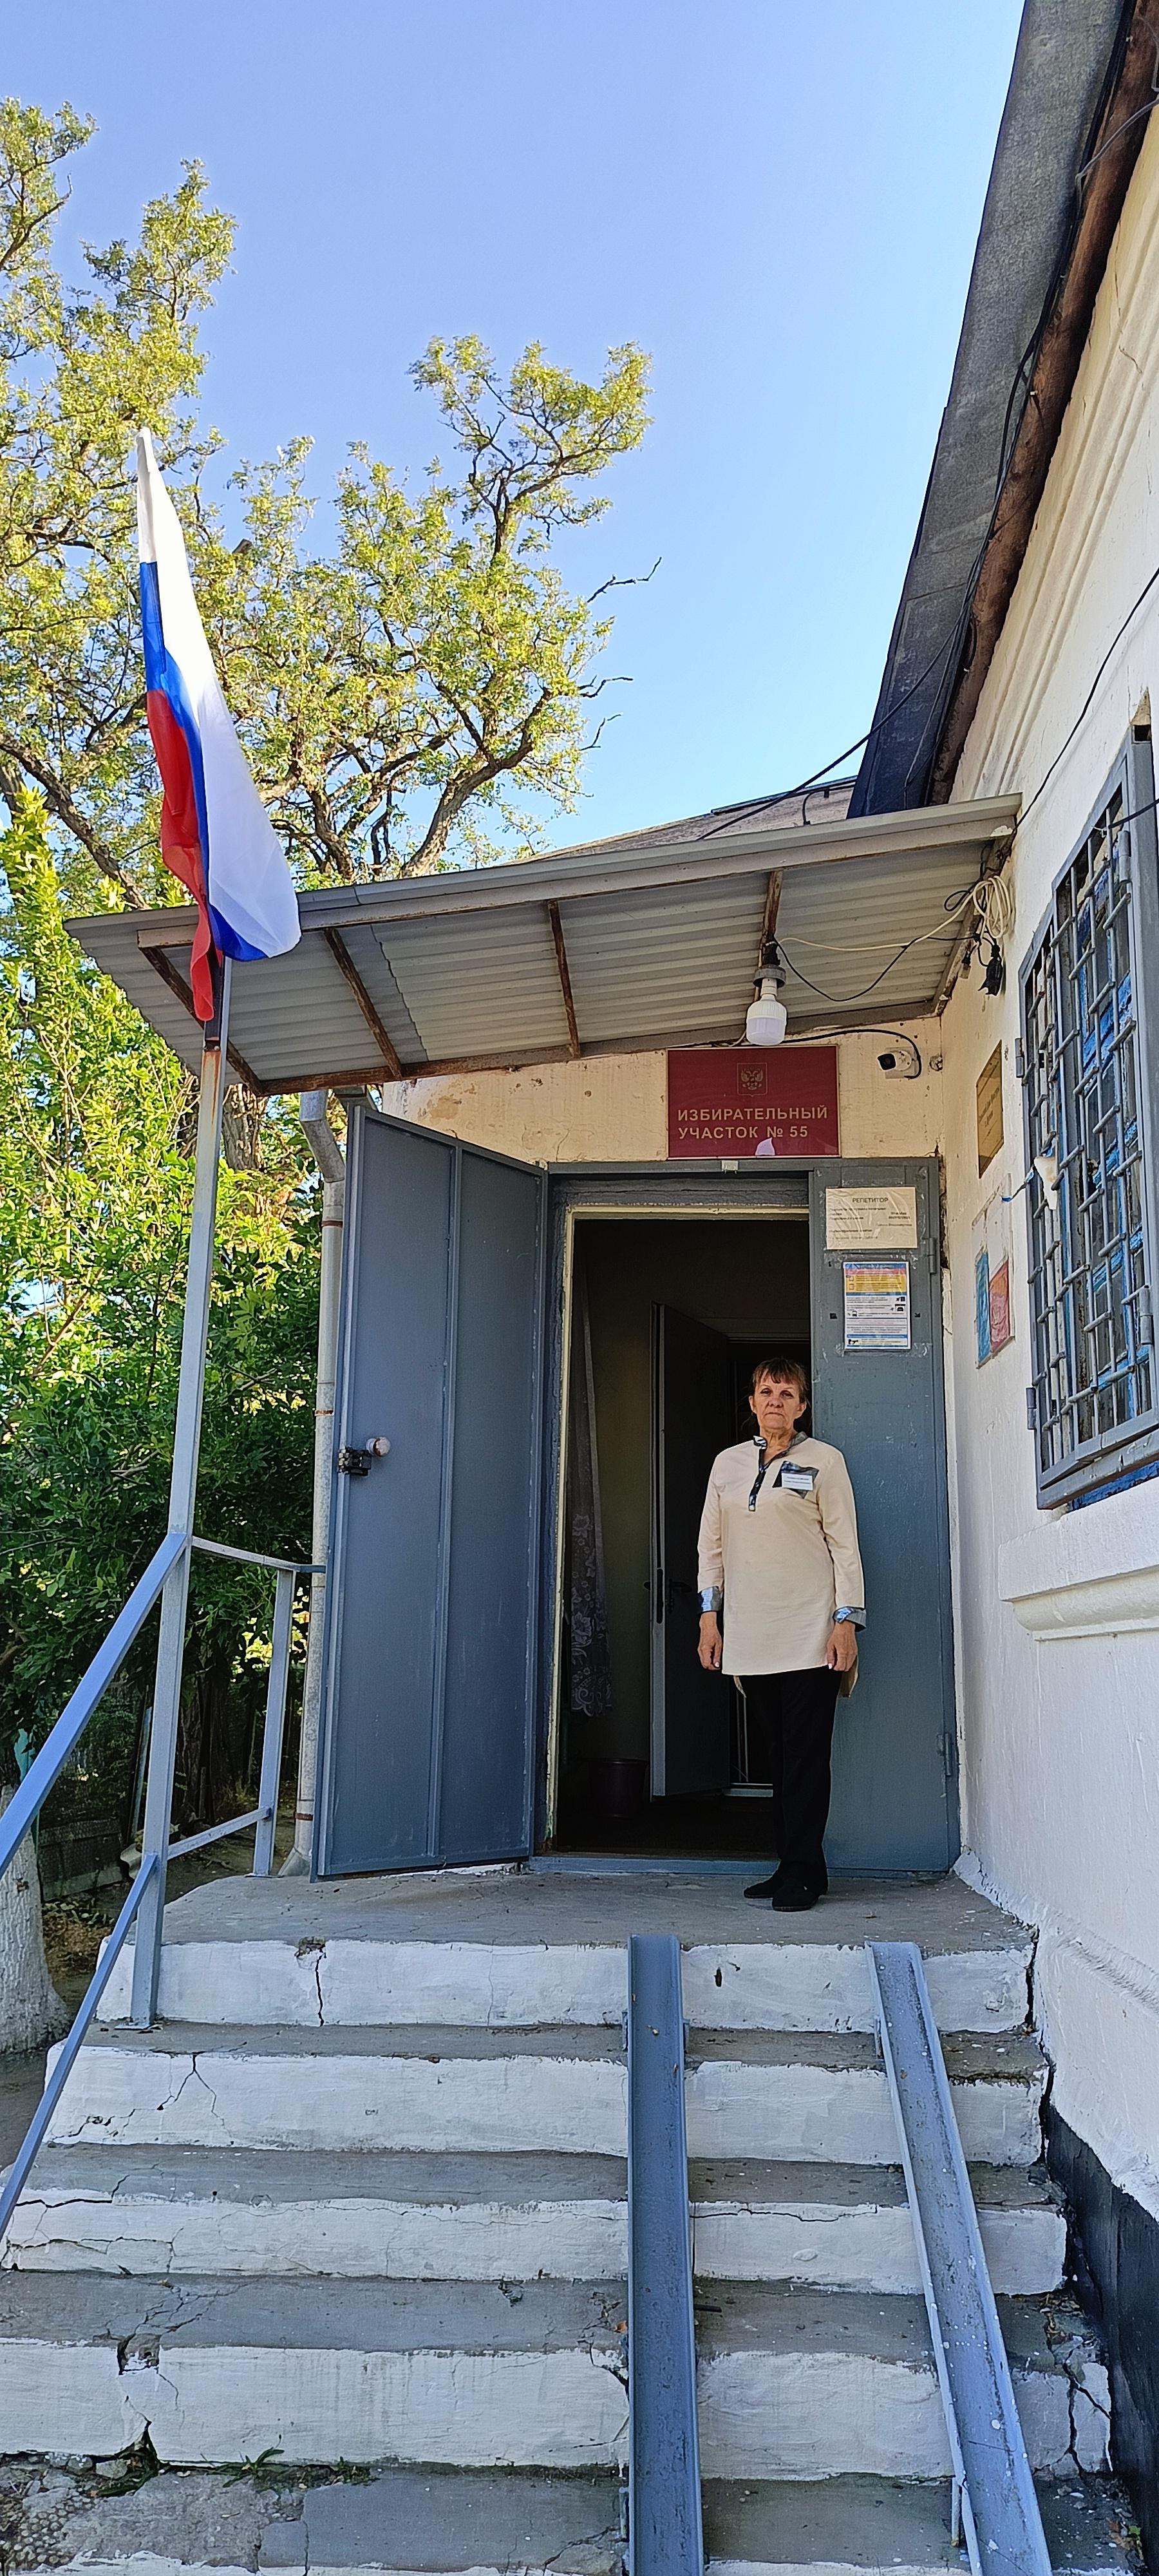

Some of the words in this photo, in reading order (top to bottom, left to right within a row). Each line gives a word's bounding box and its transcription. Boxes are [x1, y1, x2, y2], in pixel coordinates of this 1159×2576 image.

[678, 1104, 828, 1121] ИЗБИРАТЕЛЬНЫЙ
[678, 1126, 758, 1139] УЧАСТОК
[767, 1126, 784, 1138] №
[789, 1126, 808, 1137] 55
